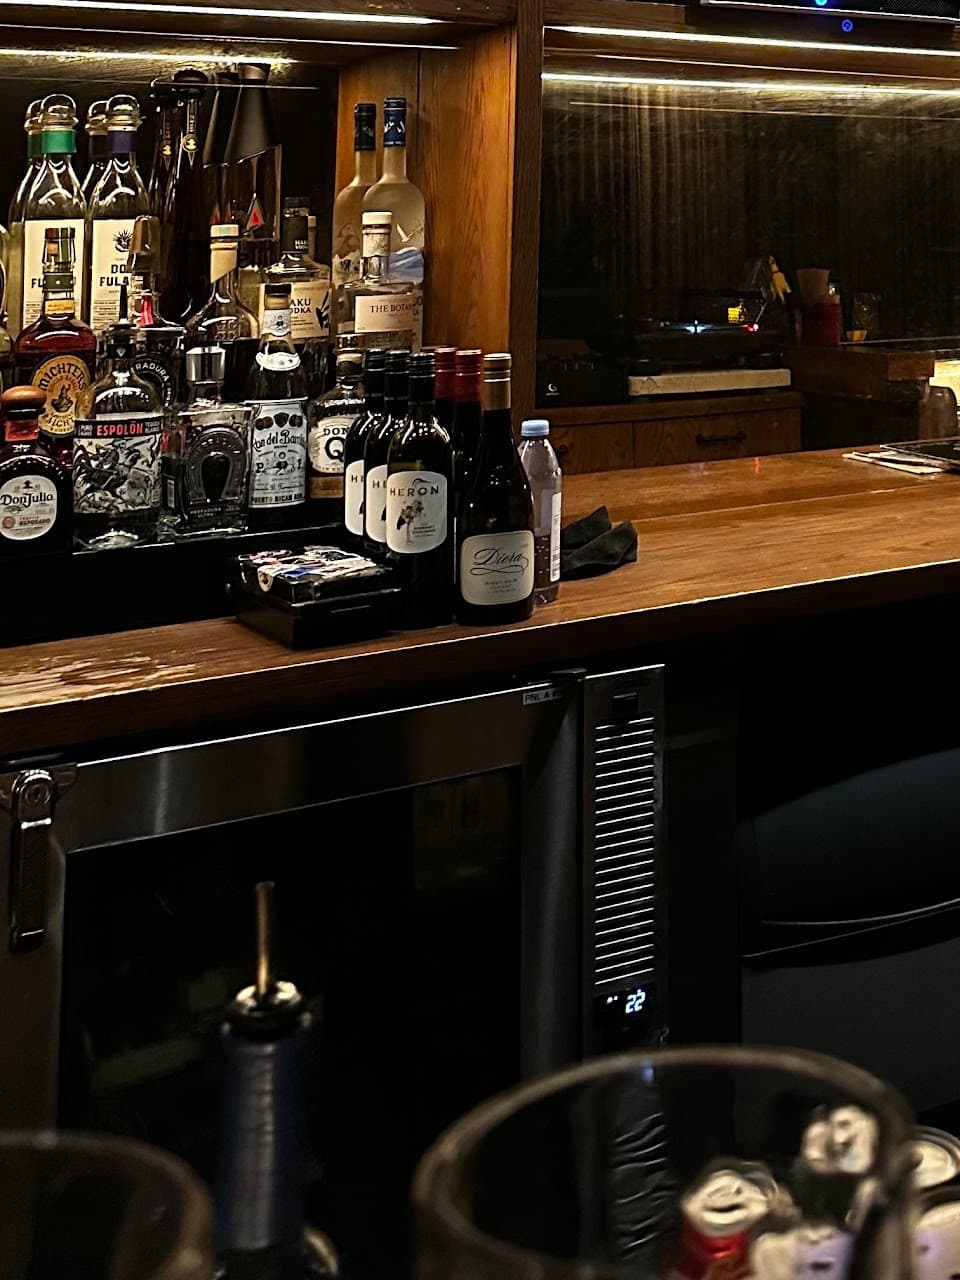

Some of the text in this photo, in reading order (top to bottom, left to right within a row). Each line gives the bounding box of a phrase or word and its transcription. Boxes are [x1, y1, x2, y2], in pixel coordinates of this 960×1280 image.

[266, 431, 279, 446] del
[324, 436, 345, 463] Q
[389, 485, 440, 497] HERON
[625, 991, 646, 1014] 22
